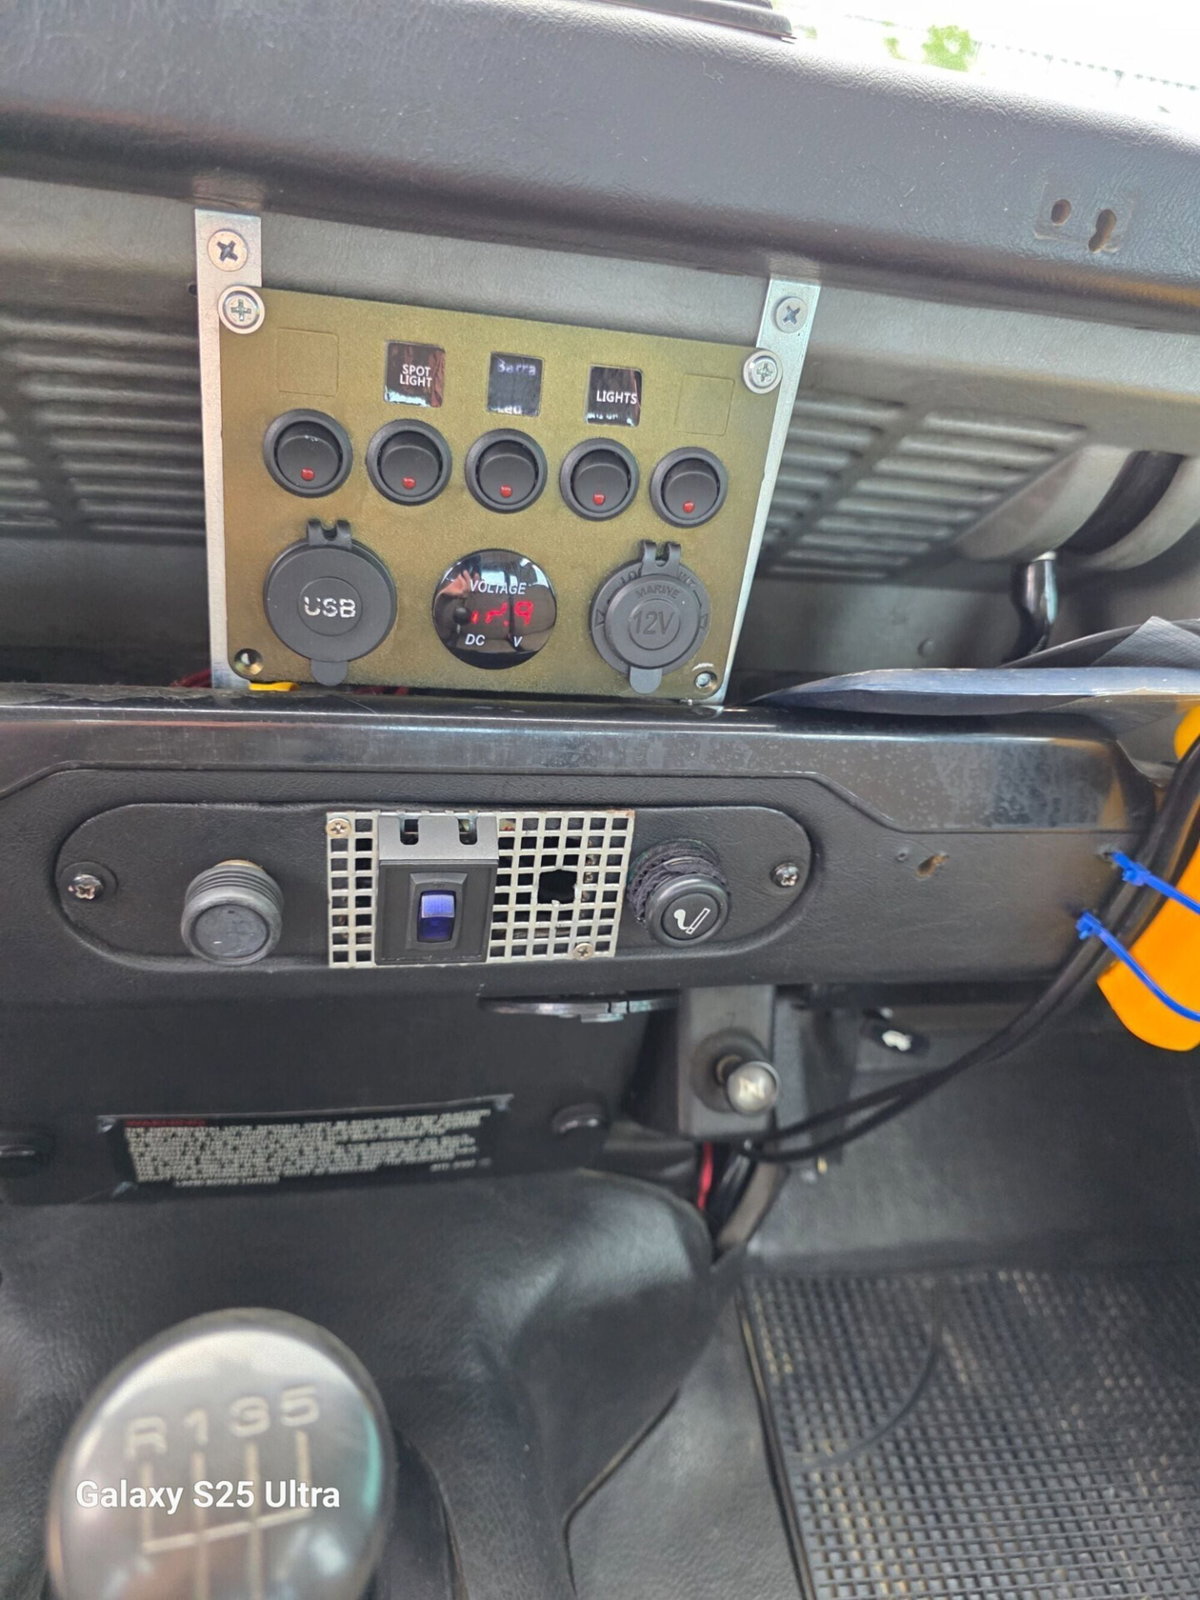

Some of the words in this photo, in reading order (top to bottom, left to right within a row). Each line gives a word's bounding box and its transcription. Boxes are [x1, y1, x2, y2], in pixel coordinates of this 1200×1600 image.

[402, 363, 431, 377] SPOT
[399, 373, 433, 388] LIGHT
[596, 389, 638, 405] LIGHTS
[469, 579, 527, 595] VOLTAGE
[635, 584, 681, 599] MARINE
[303, 596, 357, 619] USB
[632, 610, 677, 635] 12V
[464, 633, 486, 647] DC
[126, 1415, 168, 1459] R
[184, 1407, 209, 1446] 1
[227, 1395, 271, 1438] 3
[280, 1384, 321, 1427] 5
